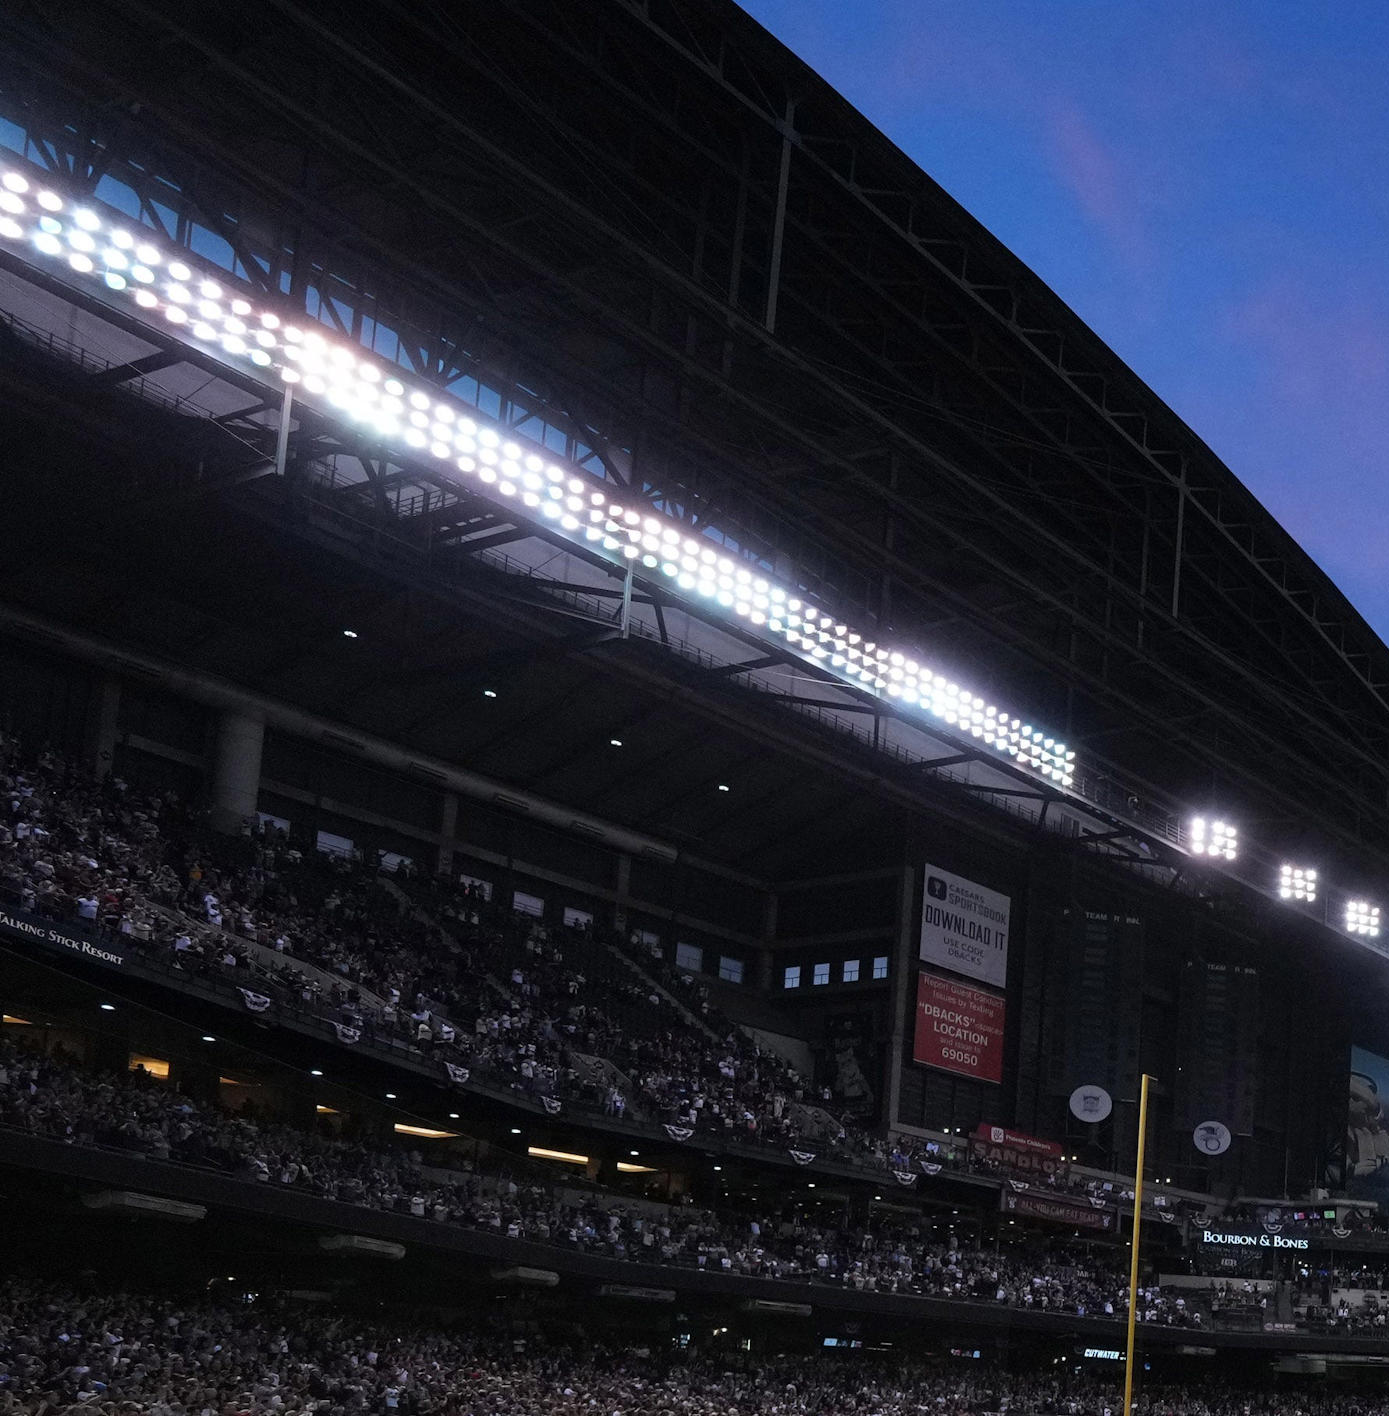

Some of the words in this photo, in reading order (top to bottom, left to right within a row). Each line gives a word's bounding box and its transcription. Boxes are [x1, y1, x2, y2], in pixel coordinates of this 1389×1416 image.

[925, 904, 991, 945] DOWNLOAD
[995, 931, 1006, 951] IT
[933, 1021, 989, 1046] LOCATION
[941, 1047, 978, 1067] 69050
[1203, 1230, 1257, 1246] BOURBON
[1259, 1234, 1271, 1246] &
[1273, 1235, 1309, 1249] BONES
